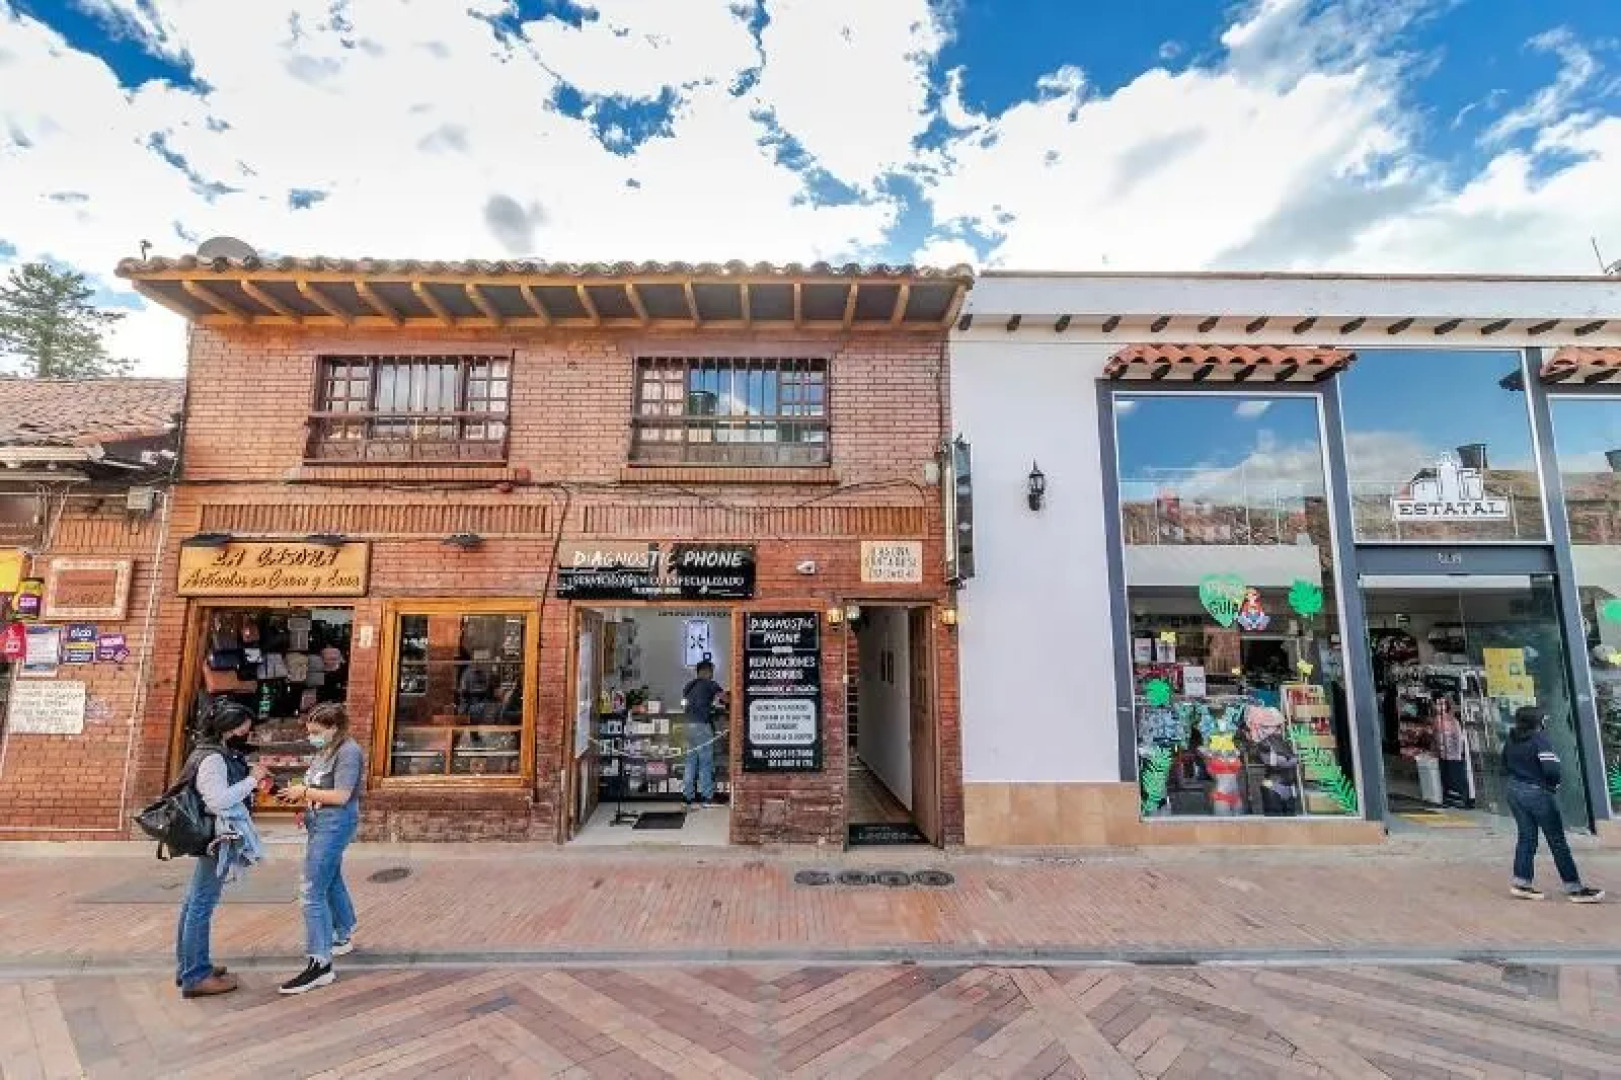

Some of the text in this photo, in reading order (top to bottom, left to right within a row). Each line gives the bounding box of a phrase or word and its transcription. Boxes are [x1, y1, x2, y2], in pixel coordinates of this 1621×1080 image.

[1398, 502, 1504, 515] ESTATAL
[573, 550, 743, 569] DIAGNOSTIC PHONE
